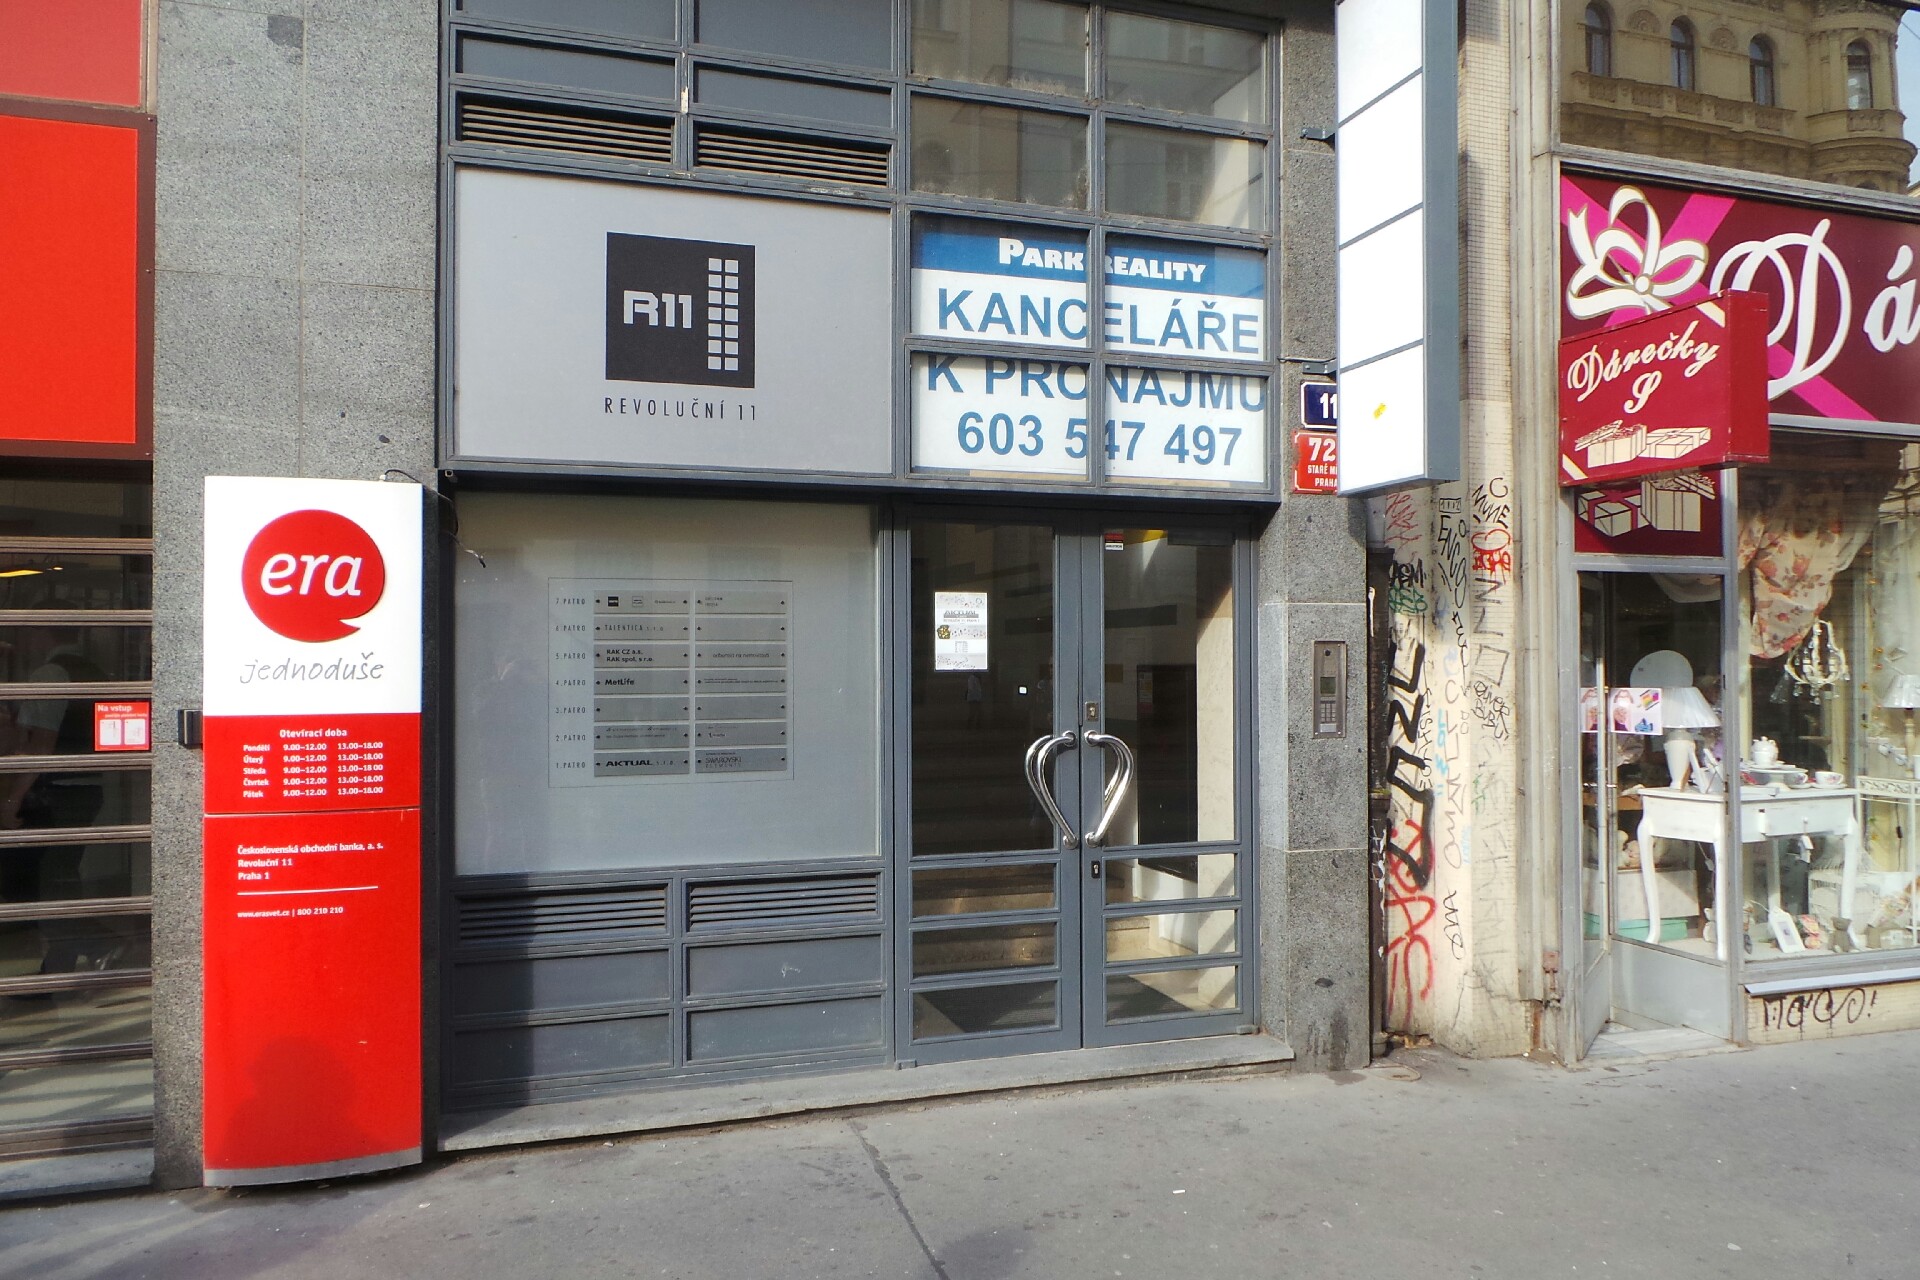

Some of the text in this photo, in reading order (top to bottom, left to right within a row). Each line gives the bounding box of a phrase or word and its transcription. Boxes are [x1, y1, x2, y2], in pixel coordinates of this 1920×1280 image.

[623, 289, 692, 329] R11
[938, 287, 1259, 354] KANCELÁŘE
[928, 354, 964, 393] K
[1567, 320, 1721, 403] Dárečky
[1624, 369, 1663, 414] S
[605, 397, 756, 421] REVOLUČNÍ 11
[958, 411, 1044, 457] 603
[1164, 424, 1242, 466] 497
[1307, 463, 1328, 475] STARÉ
[260, 553, 363, 597] era
[240, 651, 384, 684] jednoduše
[604, 678, 635, 686] MetLife
[97, 704, 132, 713] Na vstup
[279, 727, 348, 738] Otevírací doba
[237, 844, 299, 855] Československá
[300, 843, 338, 853] obchodní
[339, 842, 366, 853] banka,
[376, 842, 384, 850] s.
[237, 857, 293, 867] Revoluční 11
[237, 871, 270, 881] Praha 1
[237, 906, 344, 918] www.erasvet.cz 800 210 210
